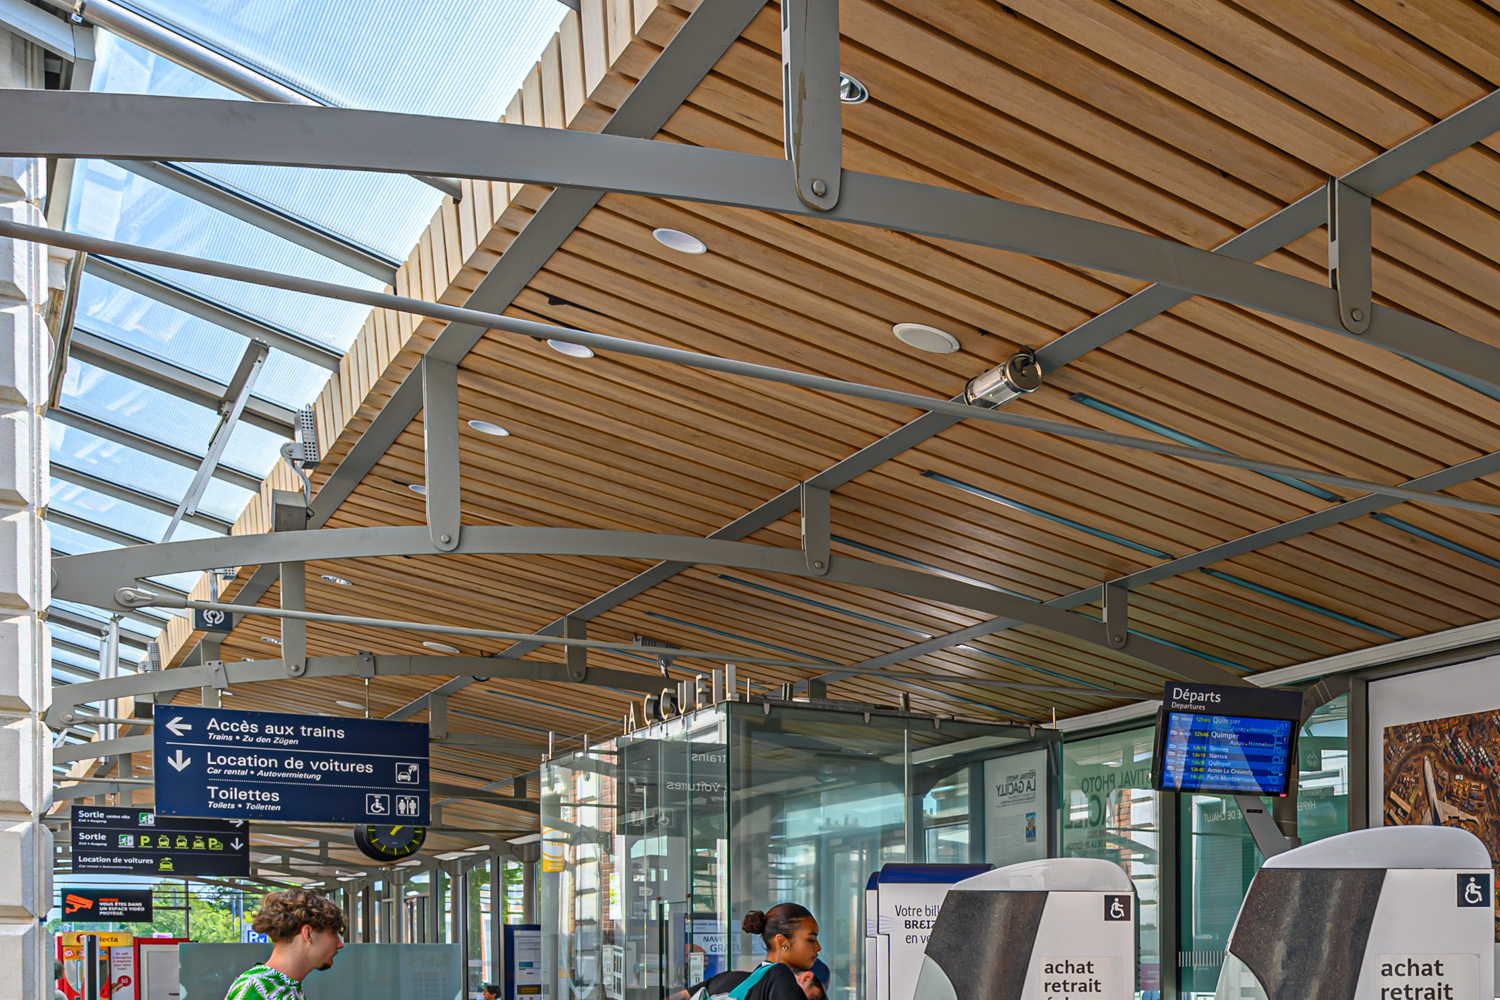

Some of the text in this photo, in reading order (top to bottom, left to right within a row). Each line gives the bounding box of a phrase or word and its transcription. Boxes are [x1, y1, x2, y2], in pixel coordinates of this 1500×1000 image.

[628, 664, 739, 733] ACCUEIL
[1172, 687, 1221, 703] Départs
[1172, 702, 1206, 711] Departures
[1212, 717, 1241, 725] Quimper
[207, 718, 345, 739] Accès aux trains
[208, 733, 299, 746] Trains Zu den Zügen
[1211, 731, 1240, 741] Quimper
[207, 752, 374, 774] Location de voitures
[207, 767, 322, 781] Car rental Autovermietung
[207, 786, 280, 802] Toilettes
[208, 801, 281, 812] Toilets Toiletten
[78, 810, 105, 819] Sortie
[79, 832, 107, 841] Sortie
[895, 905, 940, 917] Votre bill
[906, 935, 918, 944] en
[1044, 960, 1094, 975] achat
[1381, 958, 1444, 977] achat
[1044, 978, 1102, 993] retrait
[1381, 982, 1454, 1000] retrait
